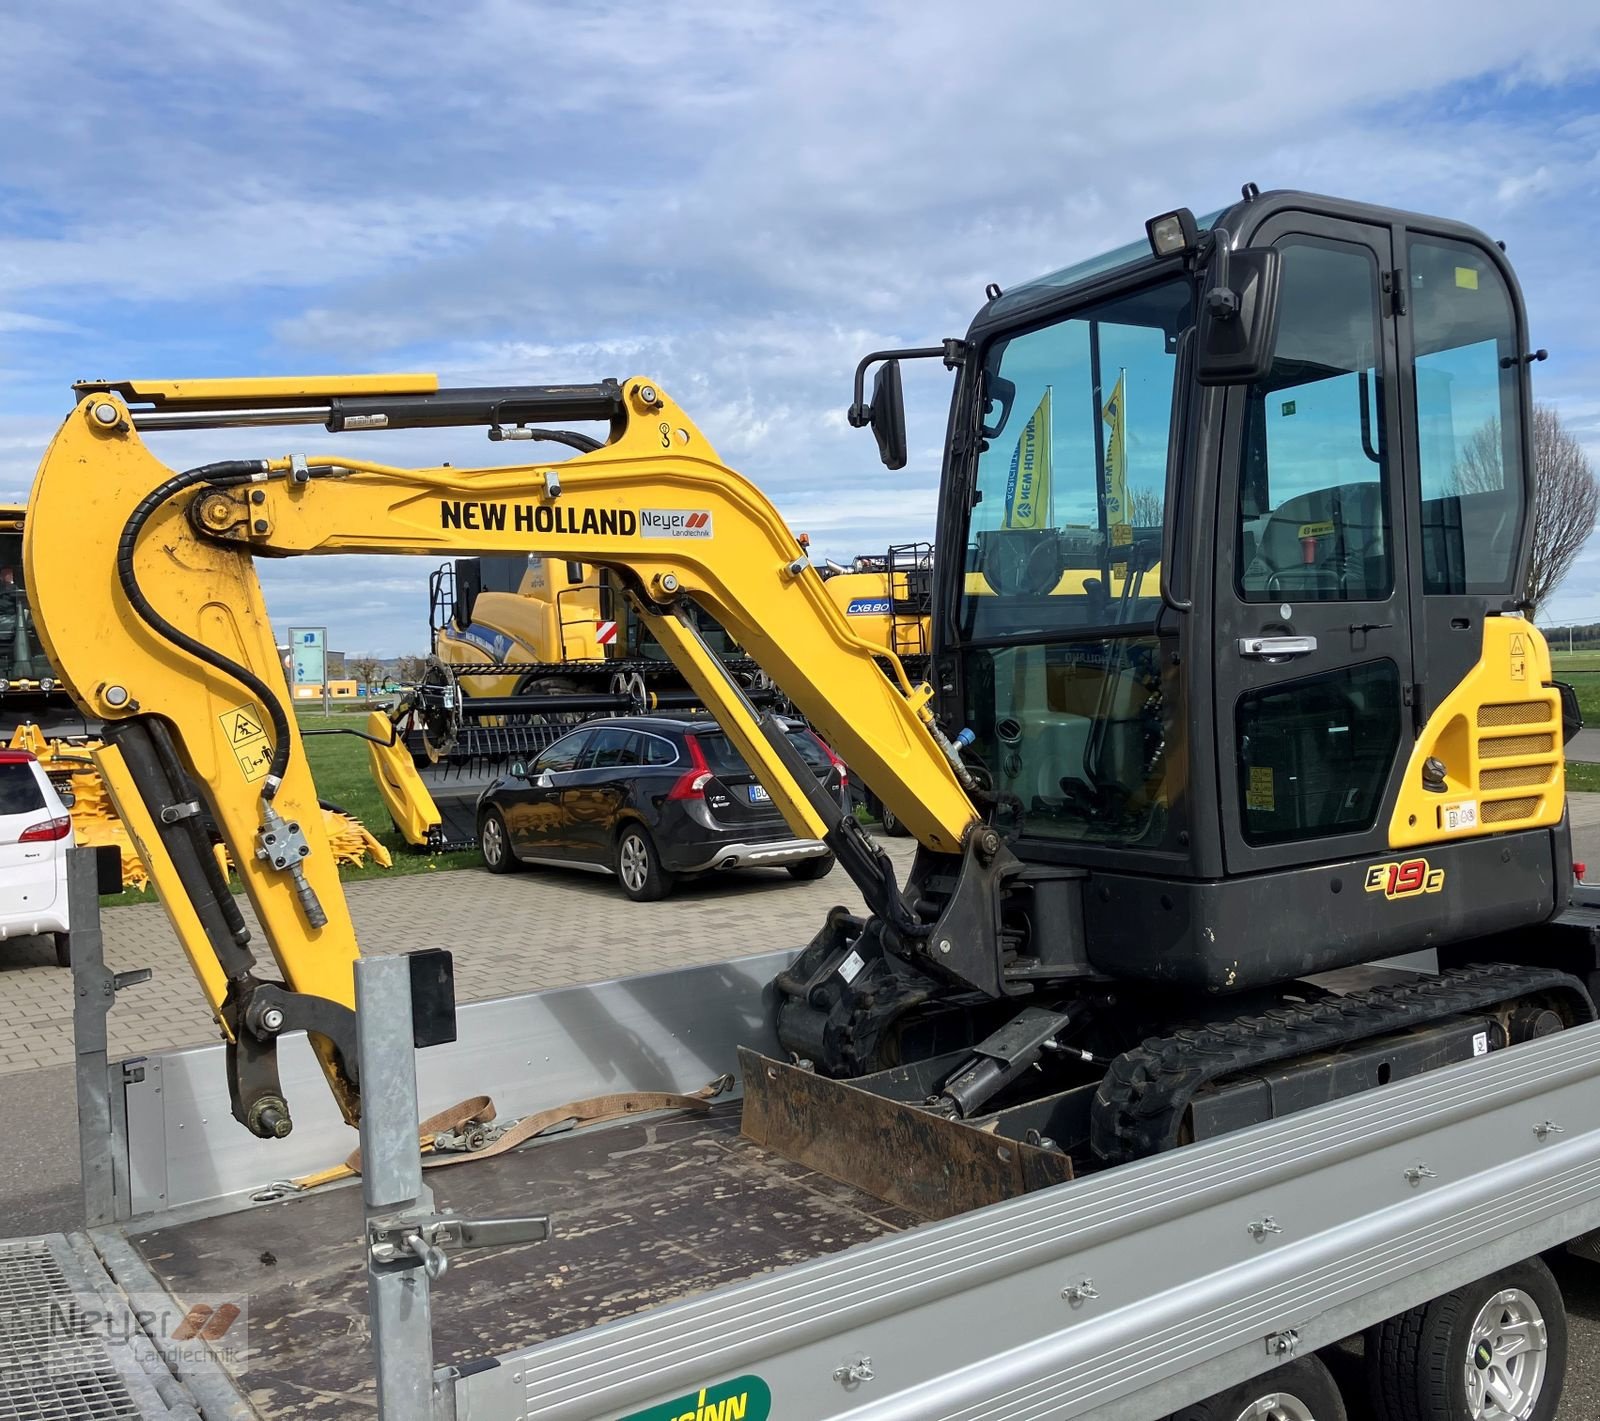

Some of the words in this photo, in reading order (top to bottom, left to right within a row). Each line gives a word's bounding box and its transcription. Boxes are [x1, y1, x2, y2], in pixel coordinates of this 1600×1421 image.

[441, 500, 507, 531] NEW
[514, 505, 636, 536] HOLLAND
[641, 511, 684, 529] Neyer
[848, 603, 890, 613] CX8.80
